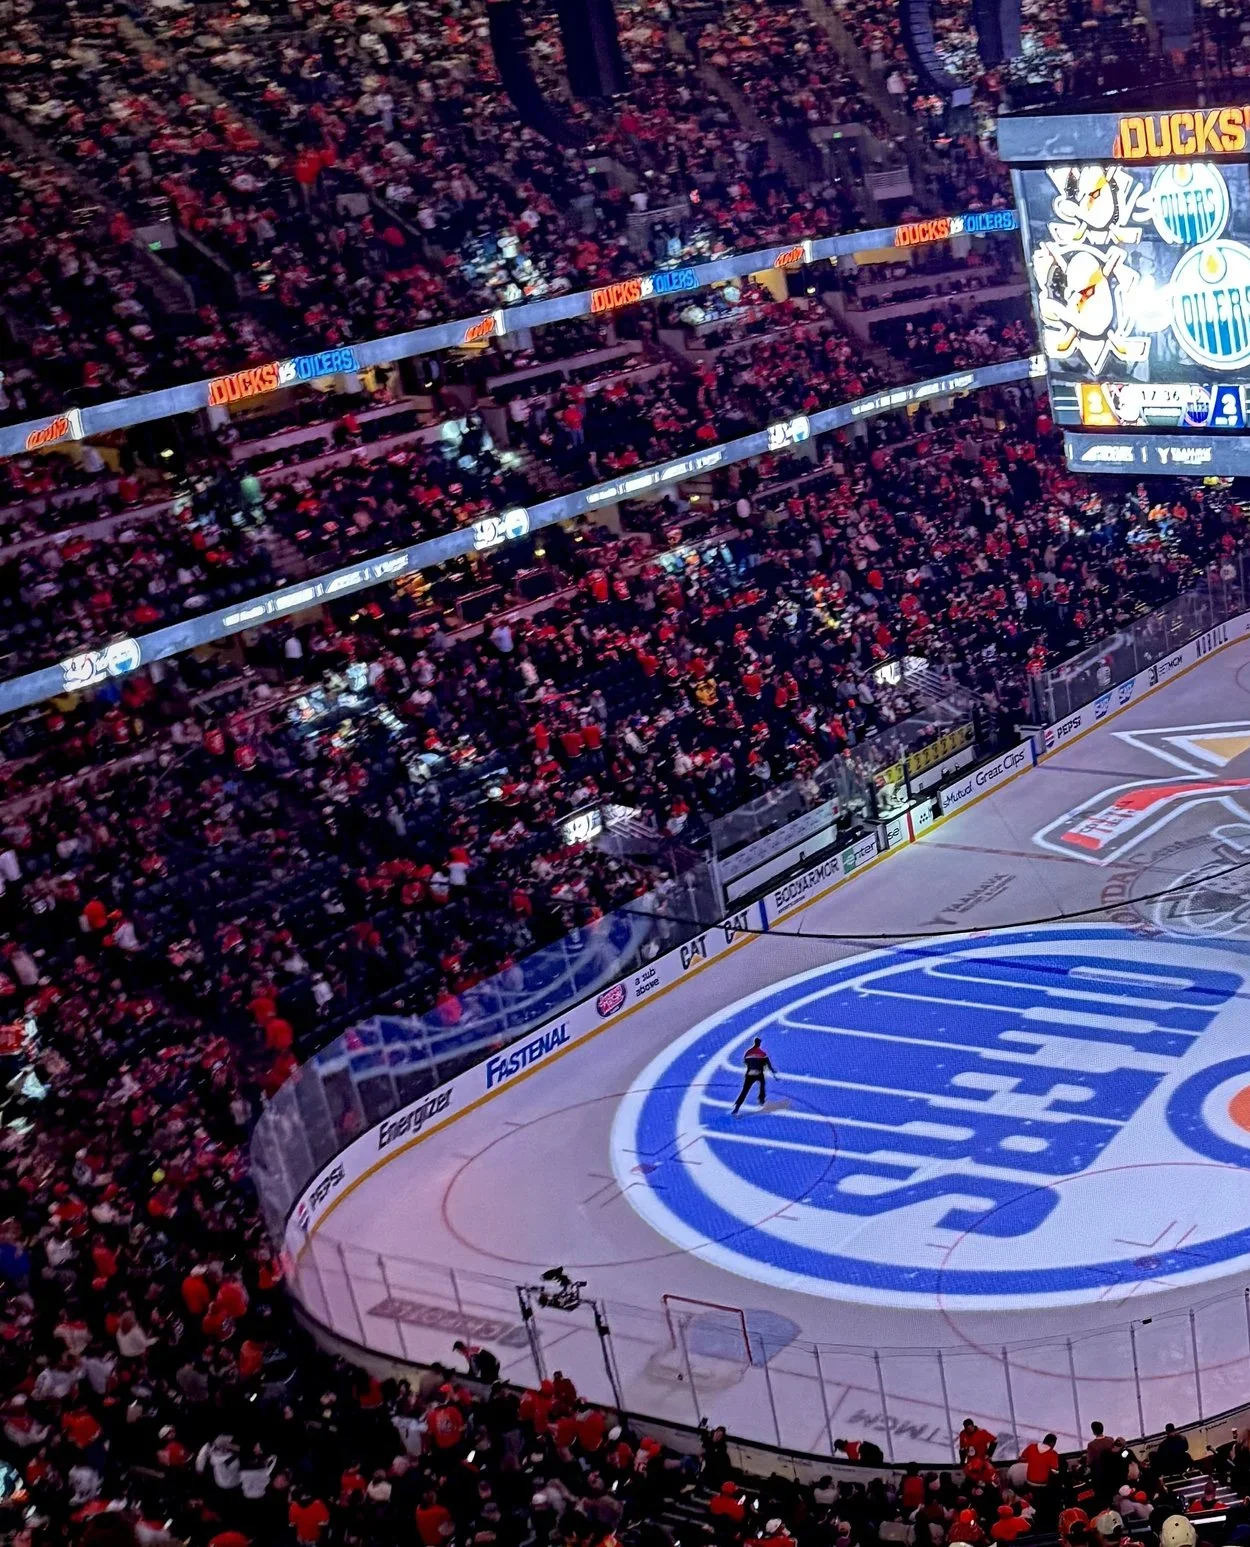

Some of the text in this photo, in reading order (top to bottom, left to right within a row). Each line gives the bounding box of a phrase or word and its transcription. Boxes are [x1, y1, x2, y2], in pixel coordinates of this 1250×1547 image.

[1119, 110, 1247, 158] DUCKS
[896, 217, 949, 246] DUCKS
[965, 211, 1015, 232] OILERS
[592, 278, 641, 312] DUCKS
[653, 269, 697, 294] OILERS
[210, 362, 279, 405] DUCKS
[298, 349, 356, 380] OILERS
[1003, 750, 1025, 770] Clips
[774, 857, 840, 908] BODYARMOR
[724, 909, 749, 944] CAT
[680, 933, 709, 970] CAT
[636, 977, 660, 997] above
[486, 1022, 571, 1089] FASTENAL
[377, 1088, 453, 1151] Energizer
